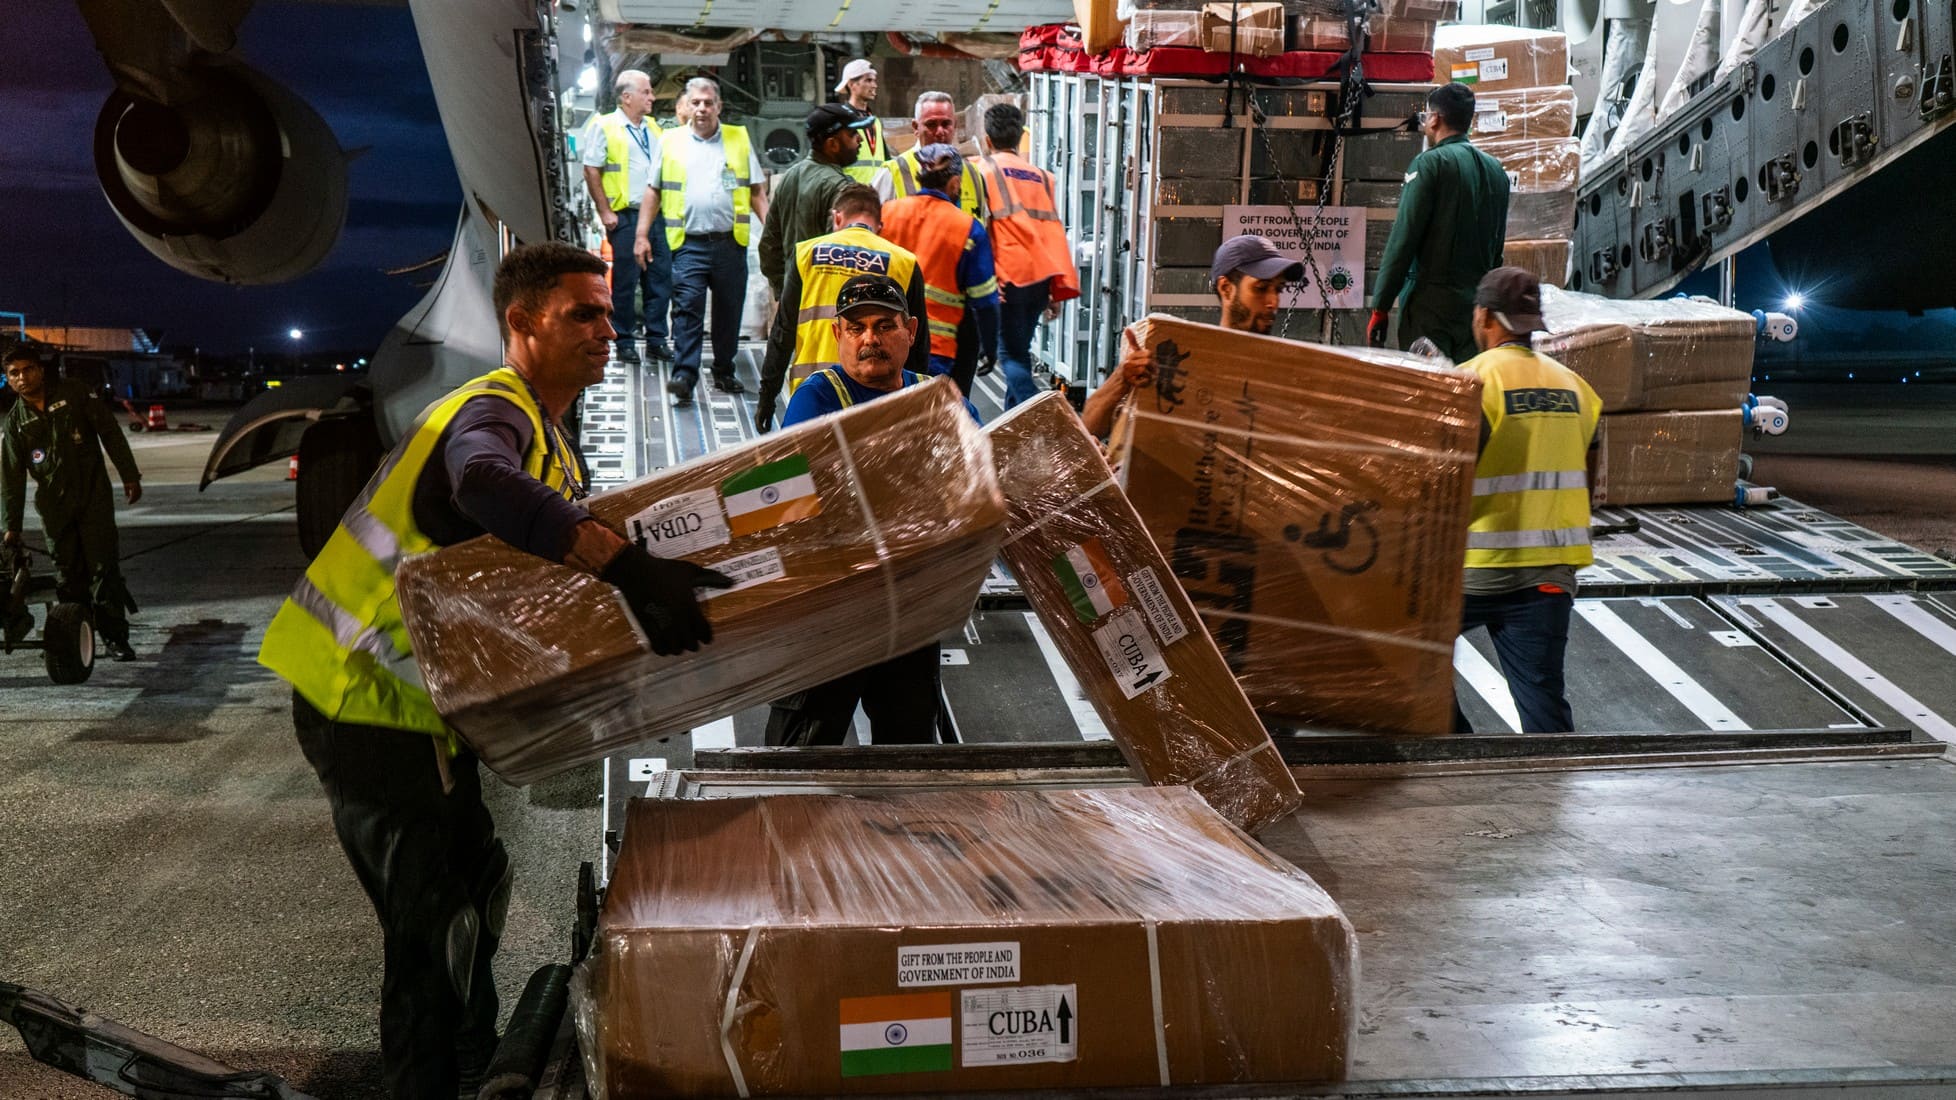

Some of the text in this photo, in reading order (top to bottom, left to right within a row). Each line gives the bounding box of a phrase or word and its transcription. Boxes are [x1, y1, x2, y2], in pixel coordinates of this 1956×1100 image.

[1240, 216, 1349, 226] GIFT FROM HE EOPLE
[1241, 228, 1263, 236] AND
[1336, 230, 1349, 238] OF
[1314, 242, 1341, 250] INDIA
[648, 512, 702, 542] CUBA
[1141, 569, 1153, 582] GIFT
[1148, 581, 1161, 596] FROM
[1155, 593, 1166, 606] THE
[1172, 621, 1182, 634] AND
[1154, 613, 1164, 624] OF
[1159, 621, 1174, 641] INDIA
[1118, 634, 1149, 676] CUBA
[901, 949, 1012, 967] GIFT FROM THE PEOPLE AND
[900, 965, 1015, 983] GOVERNMENT OF INDIA
[989, 1009, 1054, 1035] CUBA
[1018, 1048, 1045, 1058] 036
